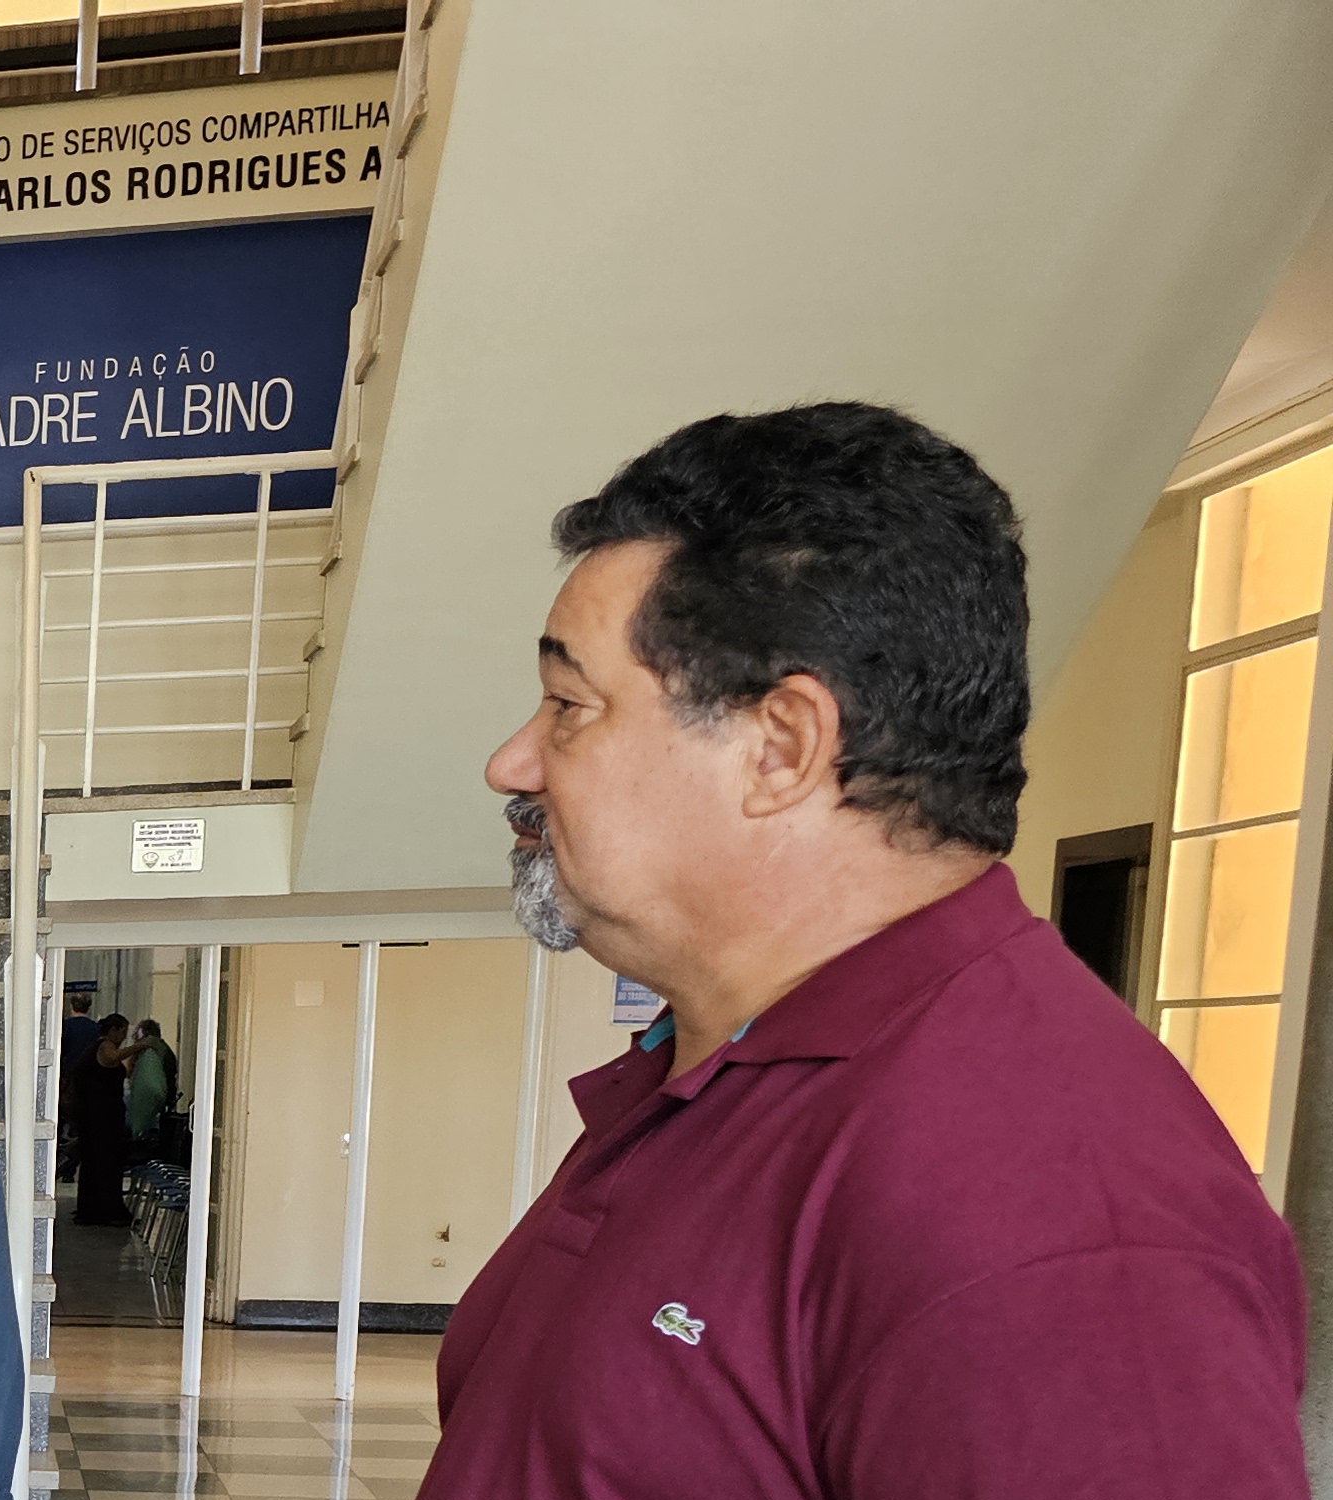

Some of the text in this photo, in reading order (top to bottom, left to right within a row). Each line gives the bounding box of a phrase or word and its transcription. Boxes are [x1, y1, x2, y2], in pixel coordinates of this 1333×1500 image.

[21, 131, 55, 160] DE
[63, 118, 192, 155] SERVIÇOS
[201, 100, 391, 143] COMPARTILHA
[126, 147, 346, 201] RODRIGUES
[358, 145, 383, 182] A
[34, 345, 216, 384] FUNDAÇÃO
[119, 376, 294, 441] ALBINO
